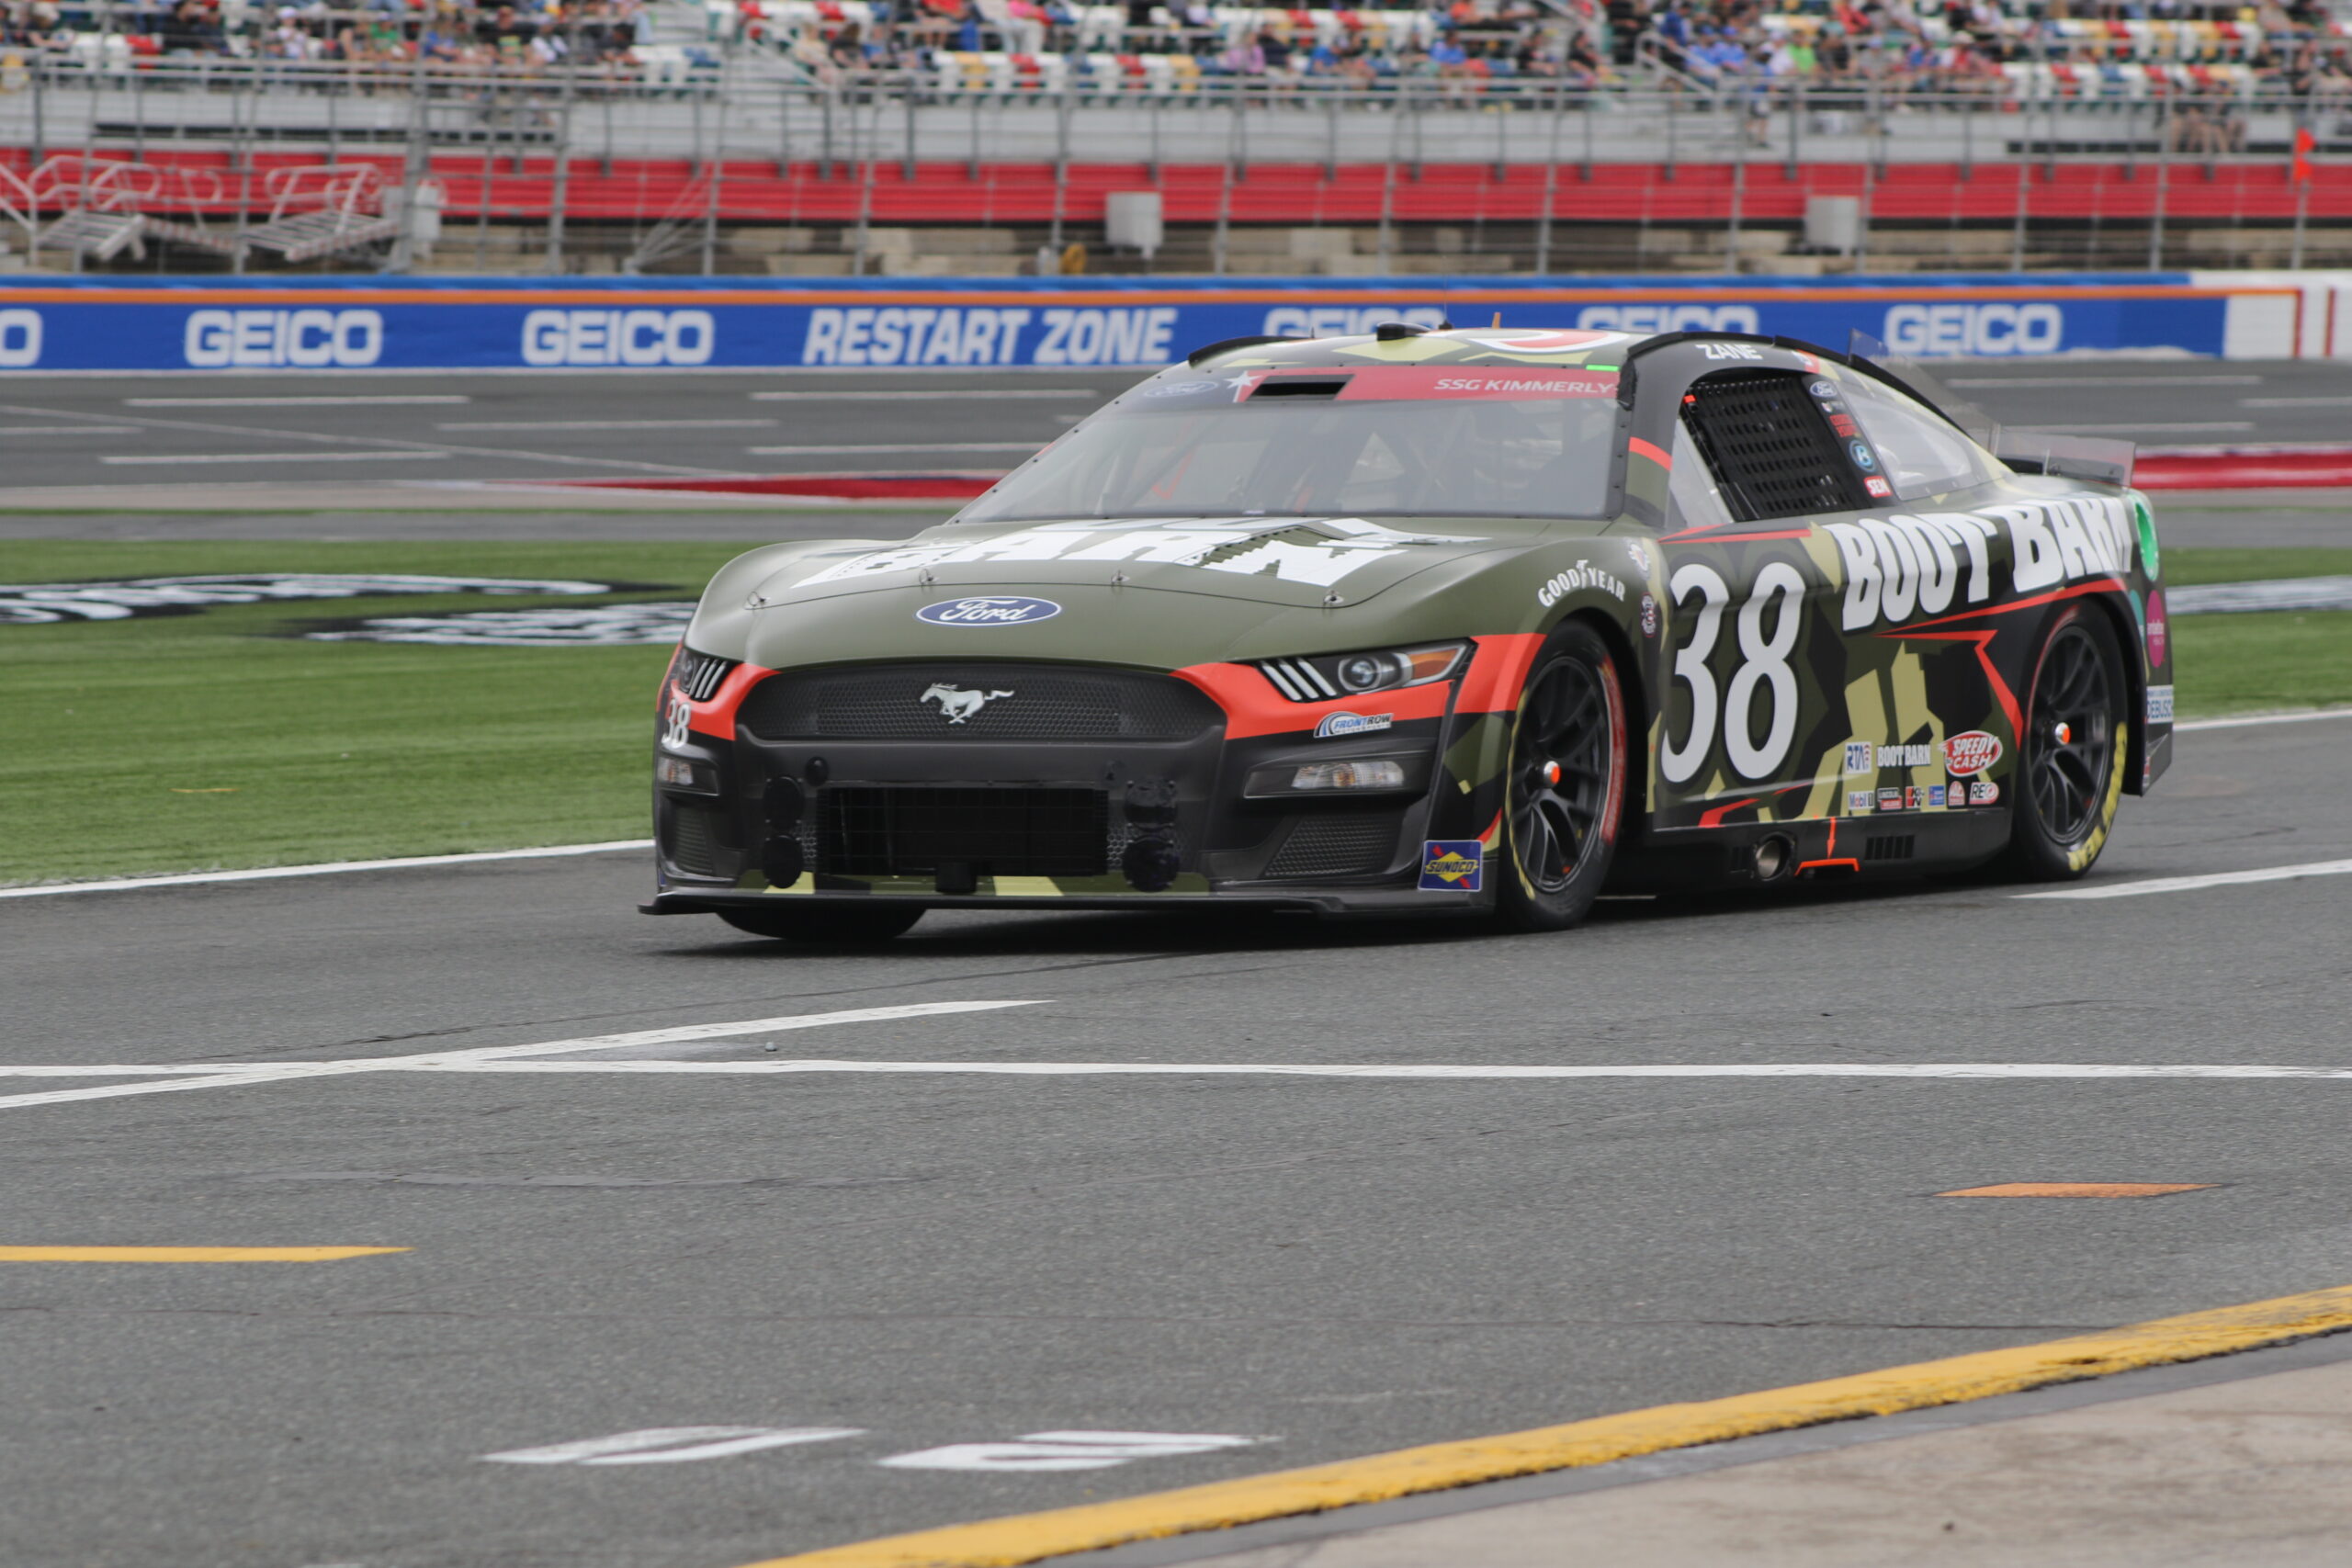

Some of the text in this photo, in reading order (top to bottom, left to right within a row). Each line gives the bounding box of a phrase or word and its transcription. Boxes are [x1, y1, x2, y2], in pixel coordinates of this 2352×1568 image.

[186, 310, 383, 366] GEICO
[521, 310, 714, 365] GEICO
[802, 308, 1177, 365] RESTART ZONE
[1695, 344, 1763, 360] ZANE
[1883, 303, 2063, 354] GEICO
[1433, 378, 1615, 393] SSG KIMMERLY
[1538, 559, 1626, 607] GOODYEAR
[1820, 491, 2132, 632] BOOT BARN
[939, 599, 1037, 621] Ford
[1661, 562, 1806, 783] 38
[662, 698, 691, 749] 38
[1951, 736, 1998, 757] SPEEDY
[1877, 744, 1931, 767] BOOT BARN
[1426, 860, 1478, 874] SUNOCO
